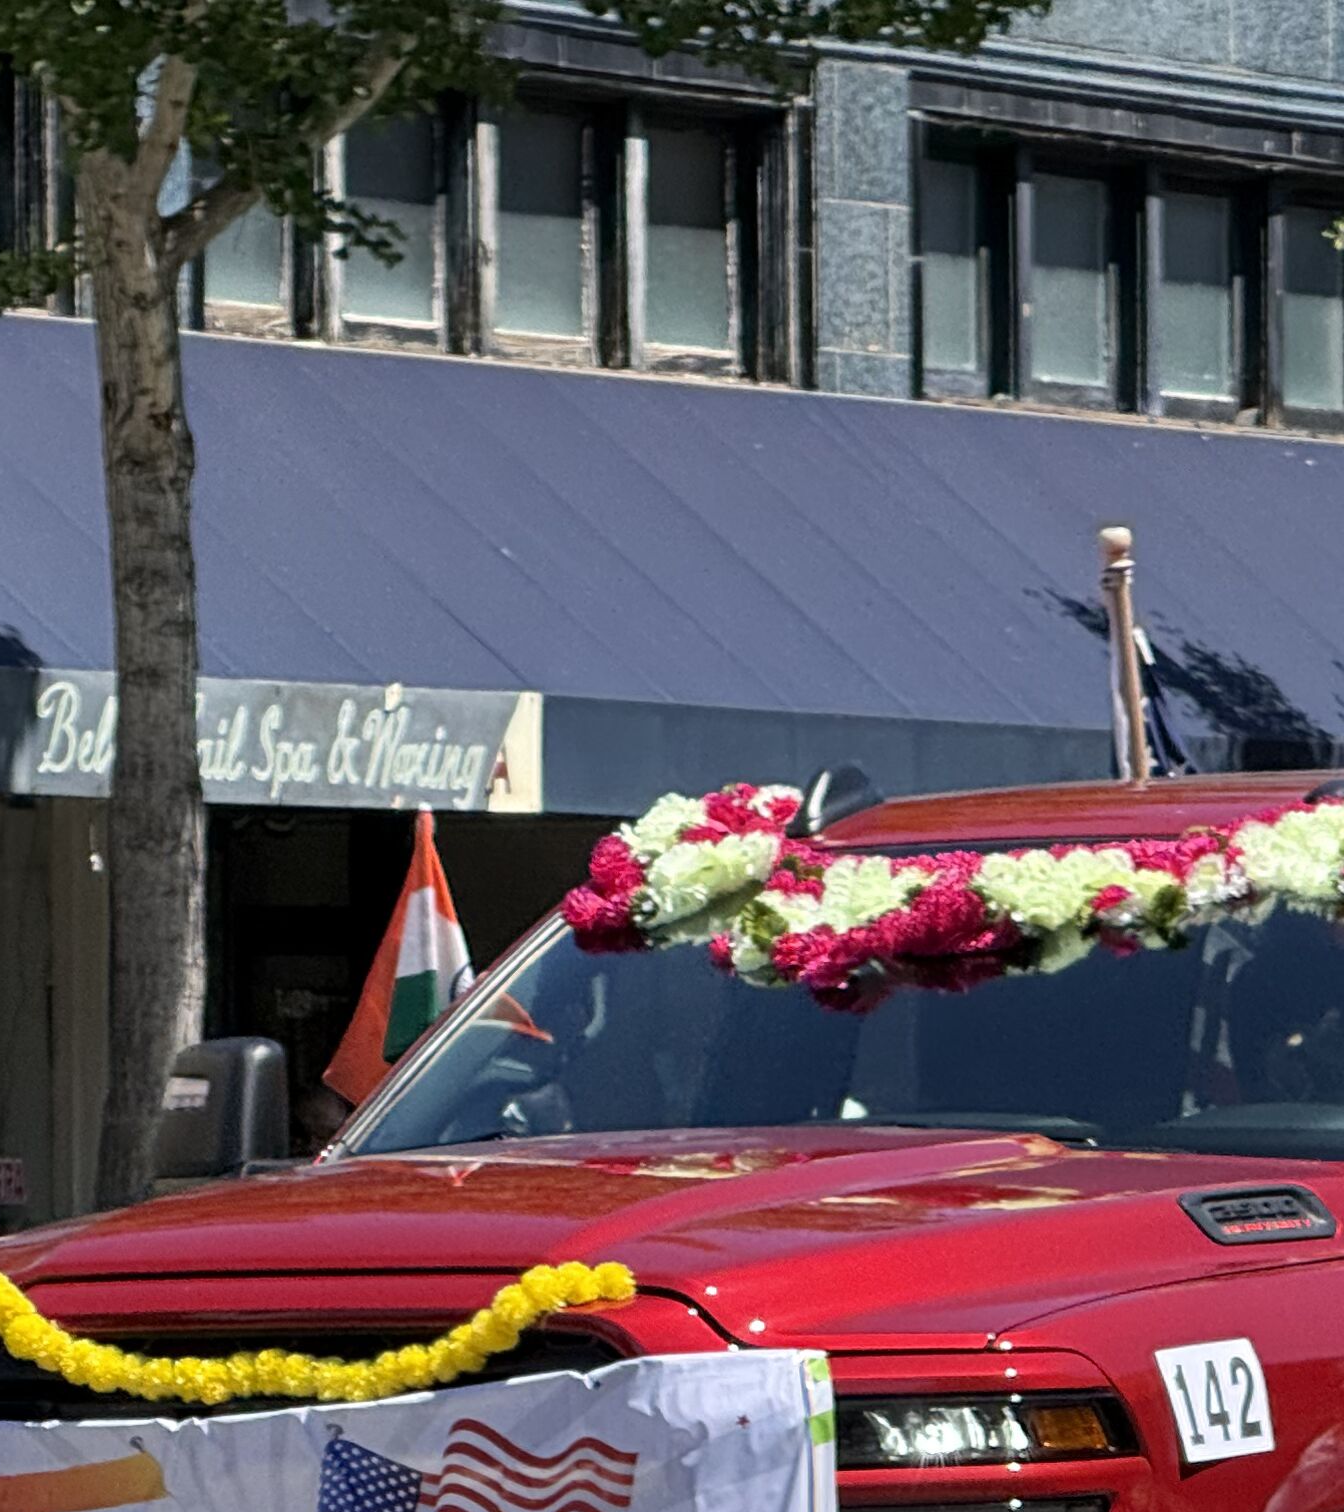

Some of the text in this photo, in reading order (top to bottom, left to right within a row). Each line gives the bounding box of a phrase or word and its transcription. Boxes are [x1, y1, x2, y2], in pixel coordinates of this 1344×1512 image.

[251, 704, 320, 800] Spa
[327, 698, 360, 785] &
[362, 705, 487, 811] Waxing
[1173, 1356, 1263, 1446] 142
